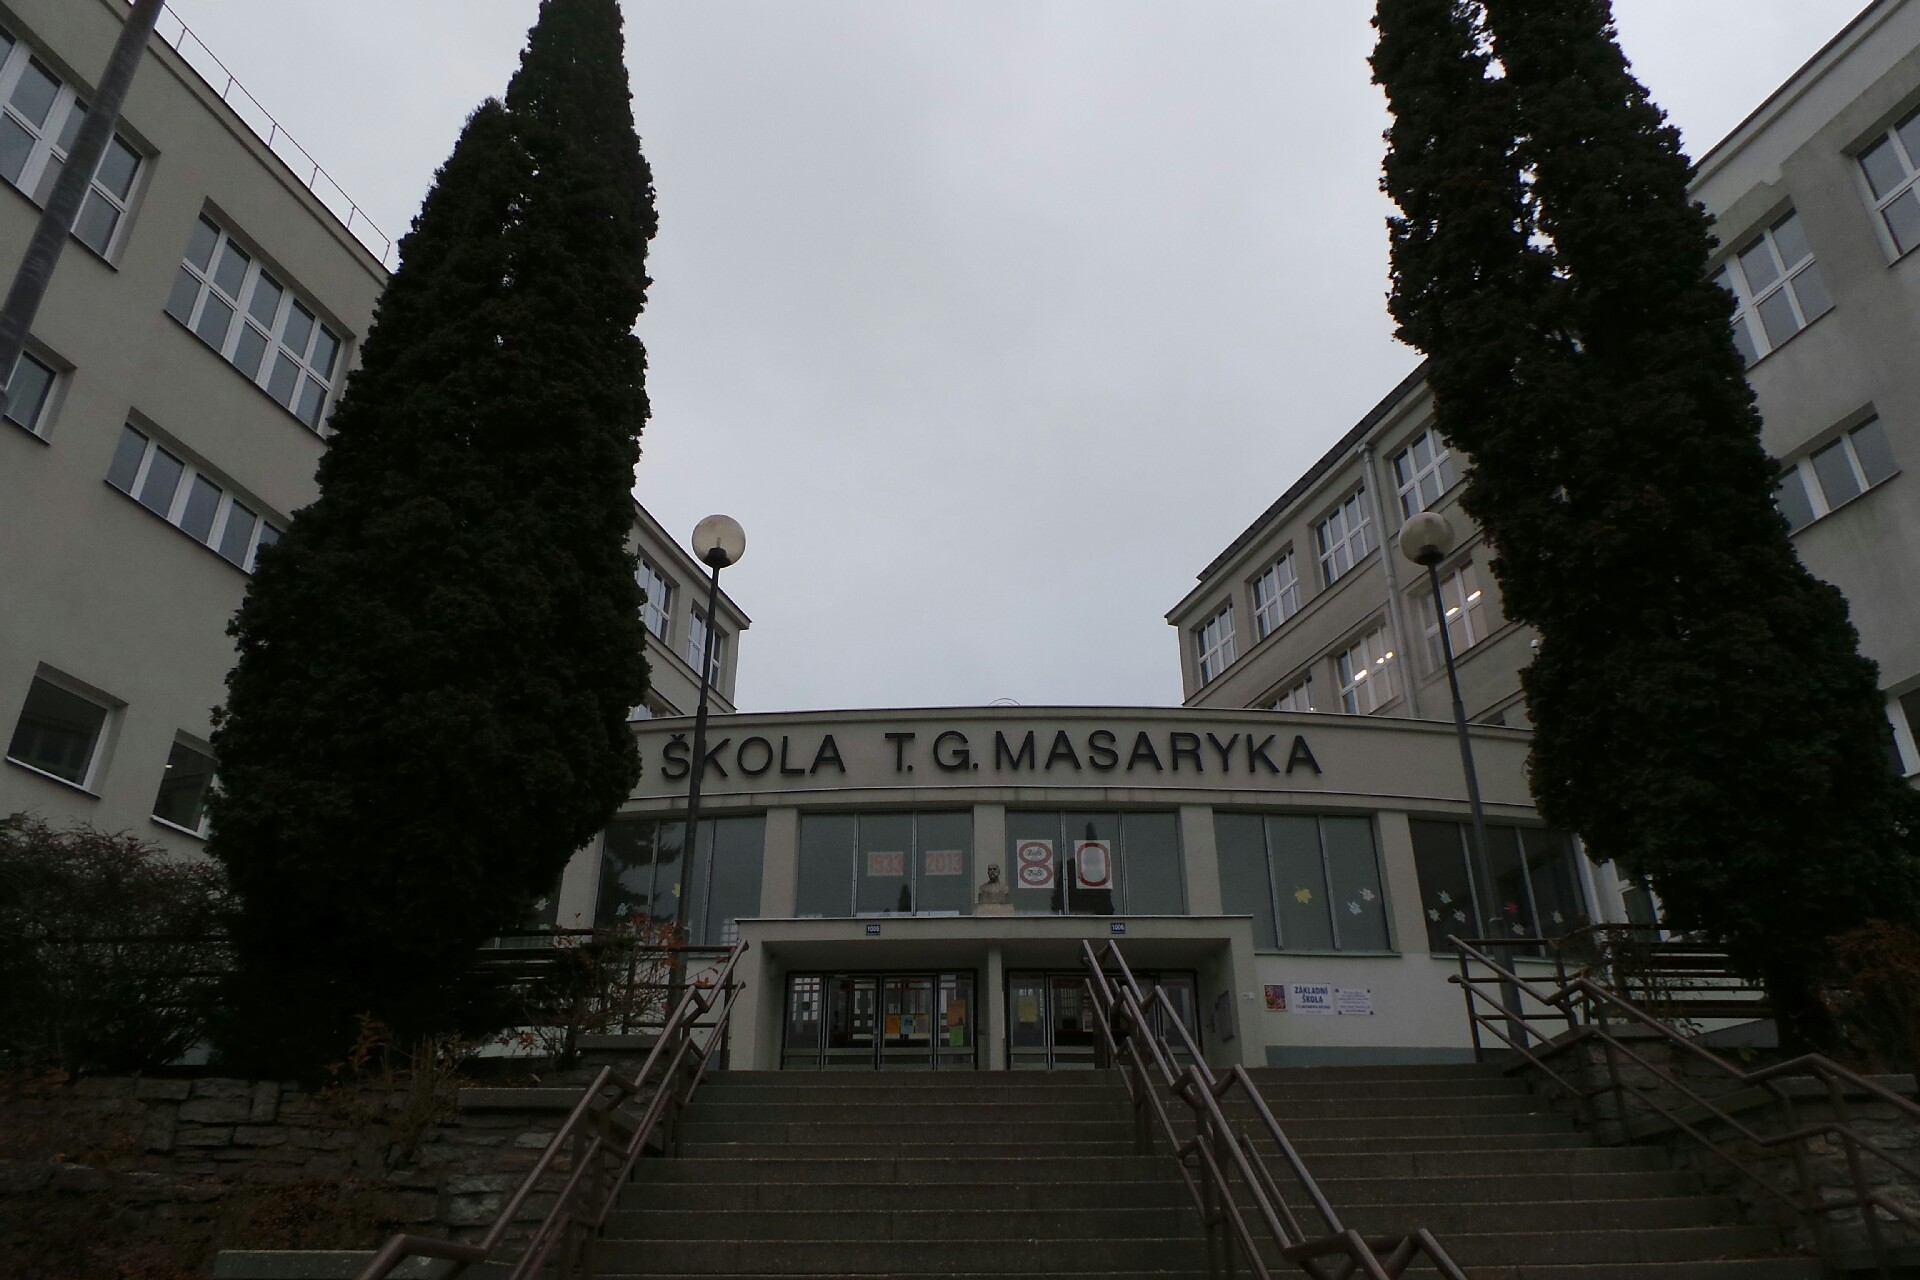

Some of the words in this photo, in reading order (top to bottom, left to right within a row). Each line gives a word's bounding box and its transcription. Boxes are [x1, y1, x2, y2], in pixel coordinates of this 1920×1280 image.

[660, 733, 847, 780] ŠKOLA
[926, 853, 962, 873] 2013
[1294, 985, 1328, 995] ZÁKLADNÍ
[1302, 994, 1323, 1003] ŠKOLA
